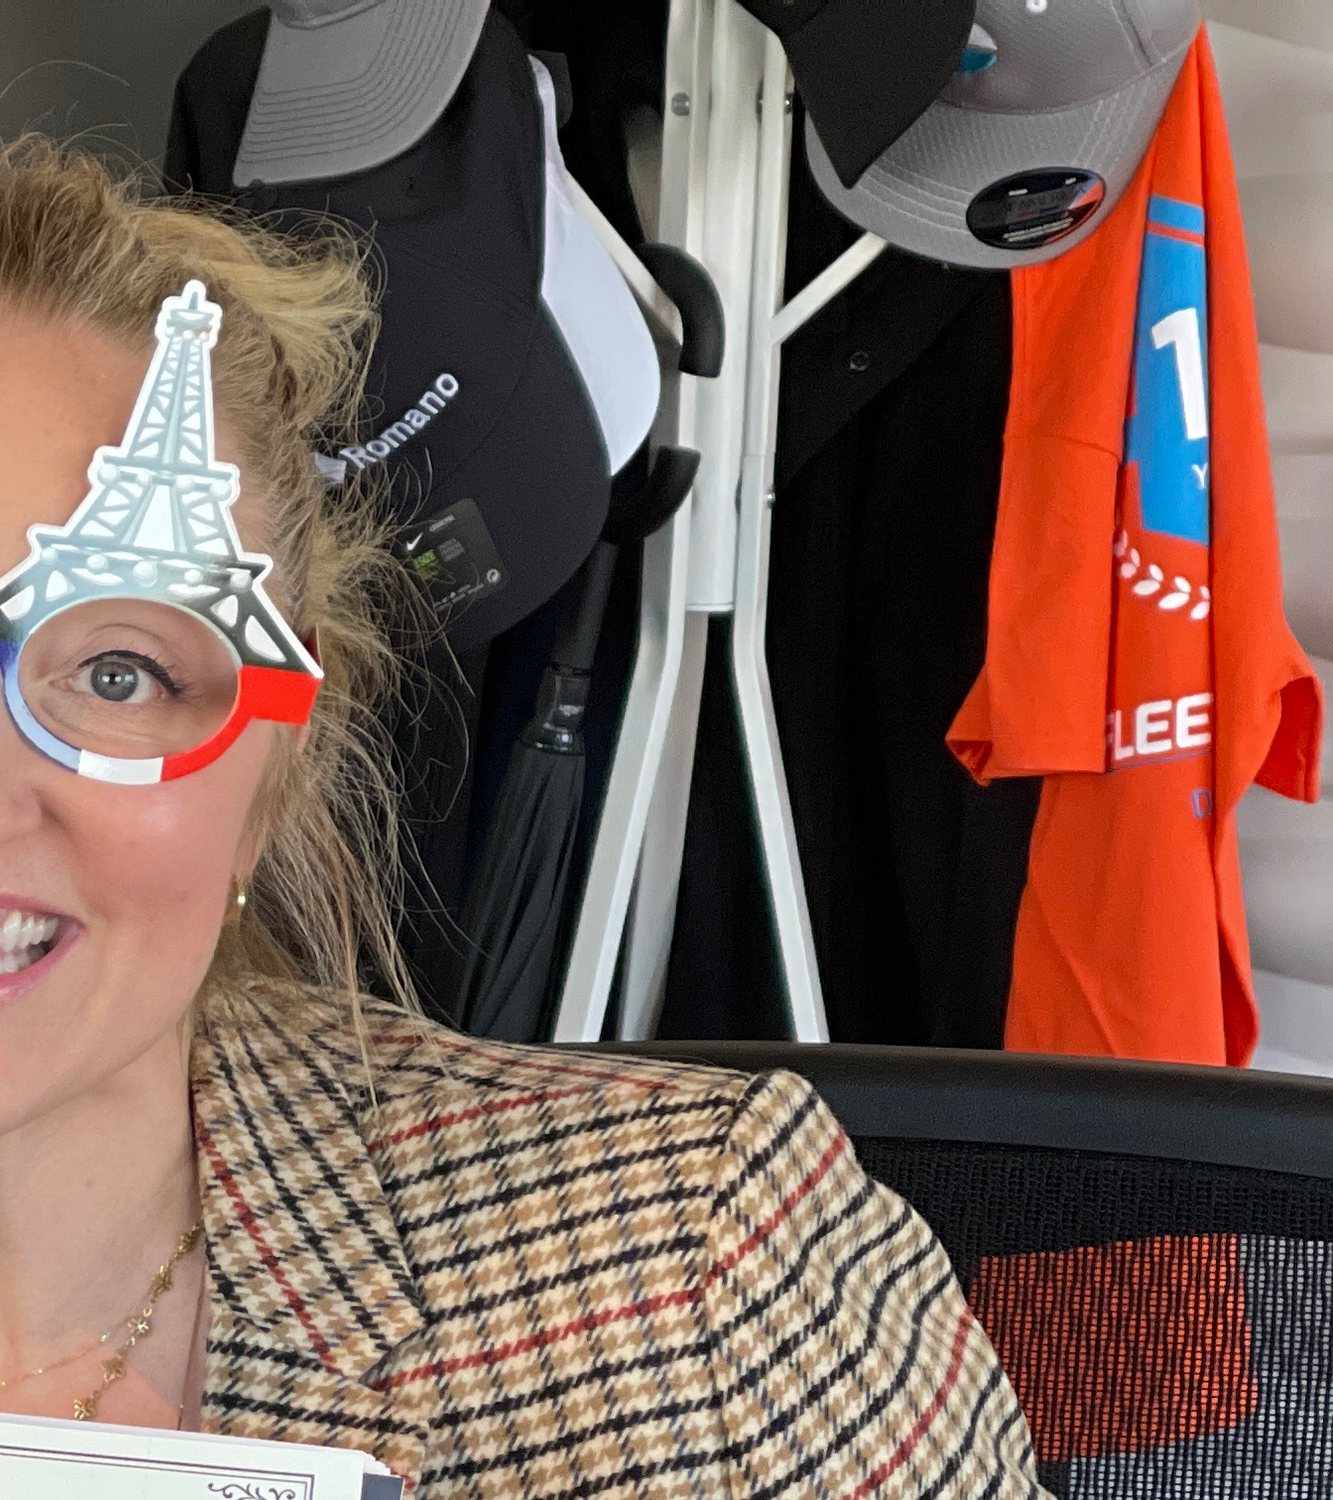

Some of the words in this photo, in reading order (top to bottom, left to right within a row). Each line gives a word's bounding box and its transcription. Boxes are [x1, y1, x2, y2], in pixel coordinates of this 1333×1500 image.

[339, 373, 459, 469] Romano
[1151, 307, 1208, 440] 1
[1106, 692, 1213, 761] LEE
